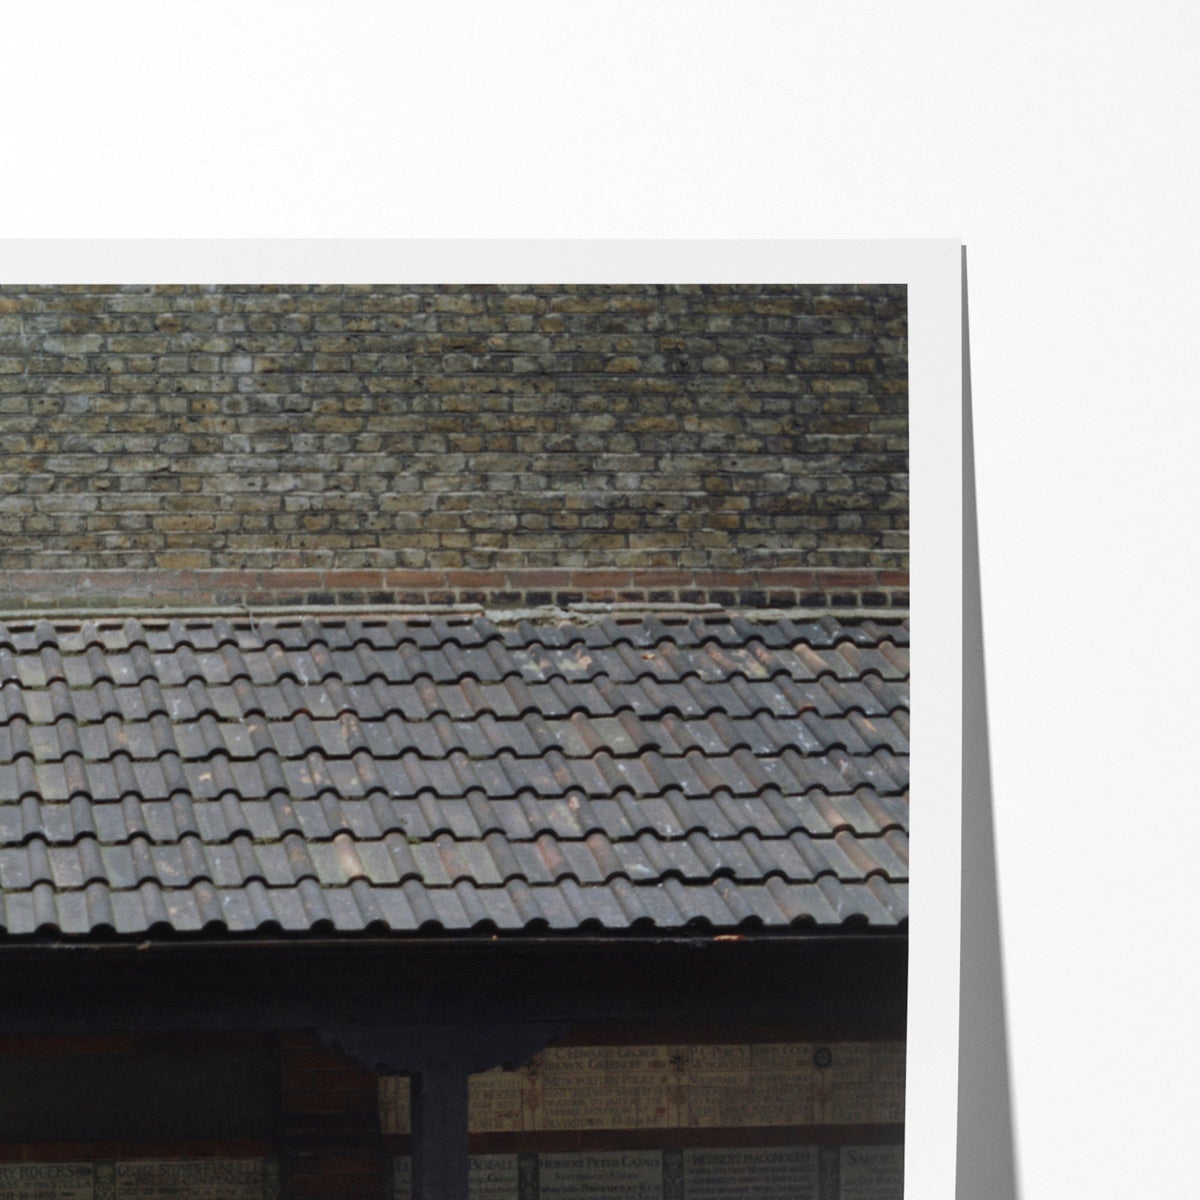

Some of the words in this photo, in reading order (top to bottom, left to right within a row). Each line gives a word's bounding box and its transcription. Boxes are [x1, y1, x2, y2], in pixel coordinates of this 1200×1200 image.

[586, 1156, 620, 1168] PETER
[621, 1154, 663, 1168] CAZALY
[18, 1165, 75, 1180] ROGERS
[50, 1179, 92, 1189] STELLA
[637, 1193, 661, 1200] SAVE
